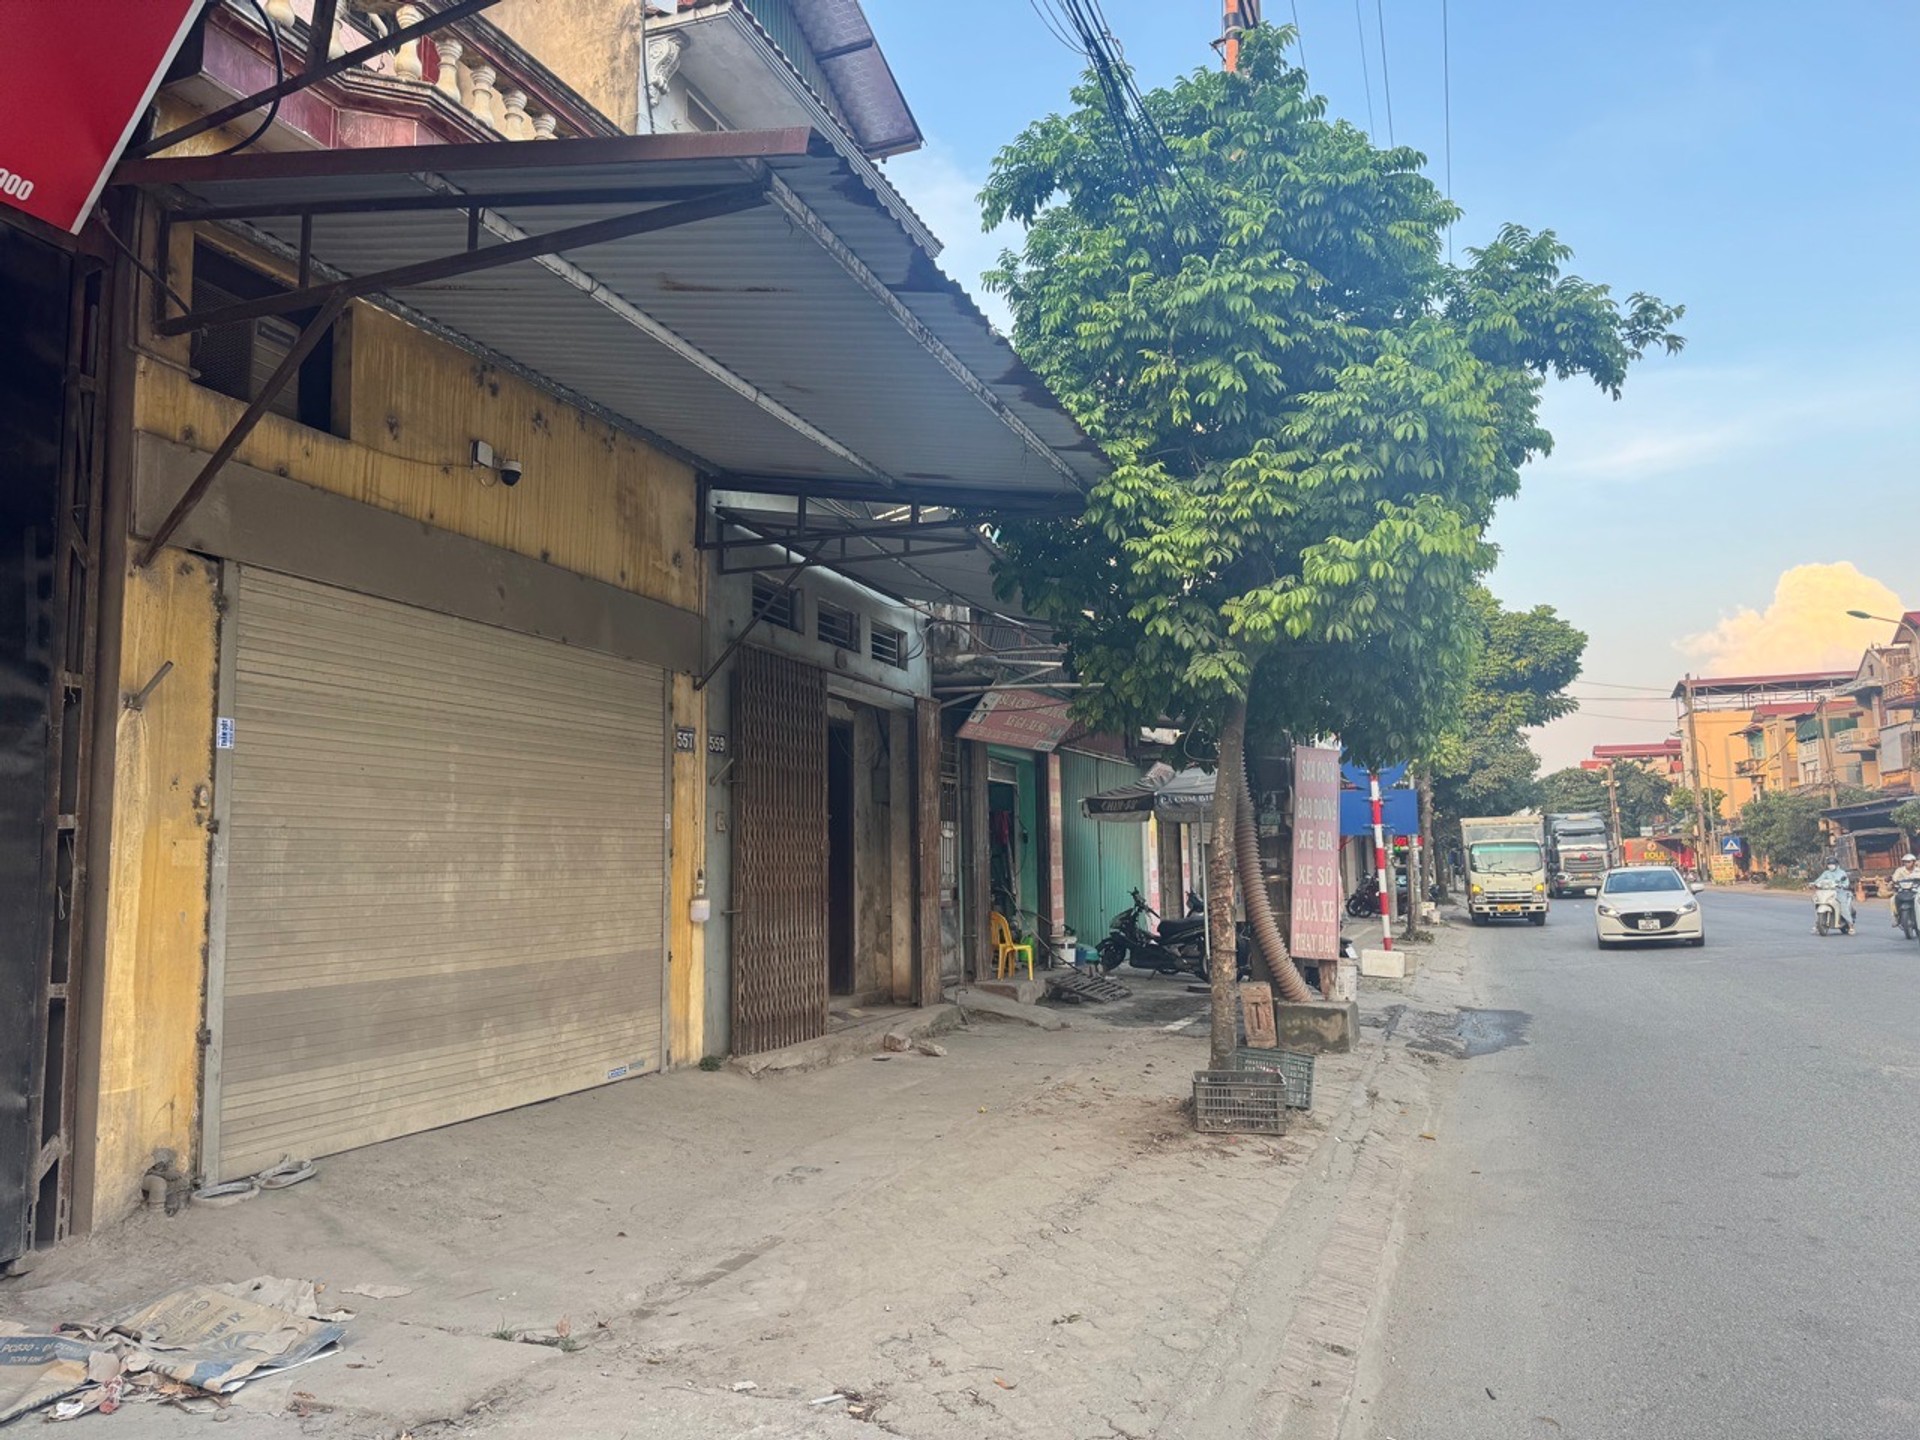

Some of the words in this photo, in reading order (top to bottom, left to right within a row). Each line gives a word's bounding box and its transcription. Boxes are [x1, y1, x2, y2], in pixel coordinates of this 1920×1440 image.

[1298, 828, 1314, 849] XE
[1318, 830, 1333, 851] GA
[1298, 863, 1313, 885] XE
[1317, 859, 1334, 887] SỐ
[1321, 900, 1336, 924] XE
[1294, 932, 1316, 952] THAY
